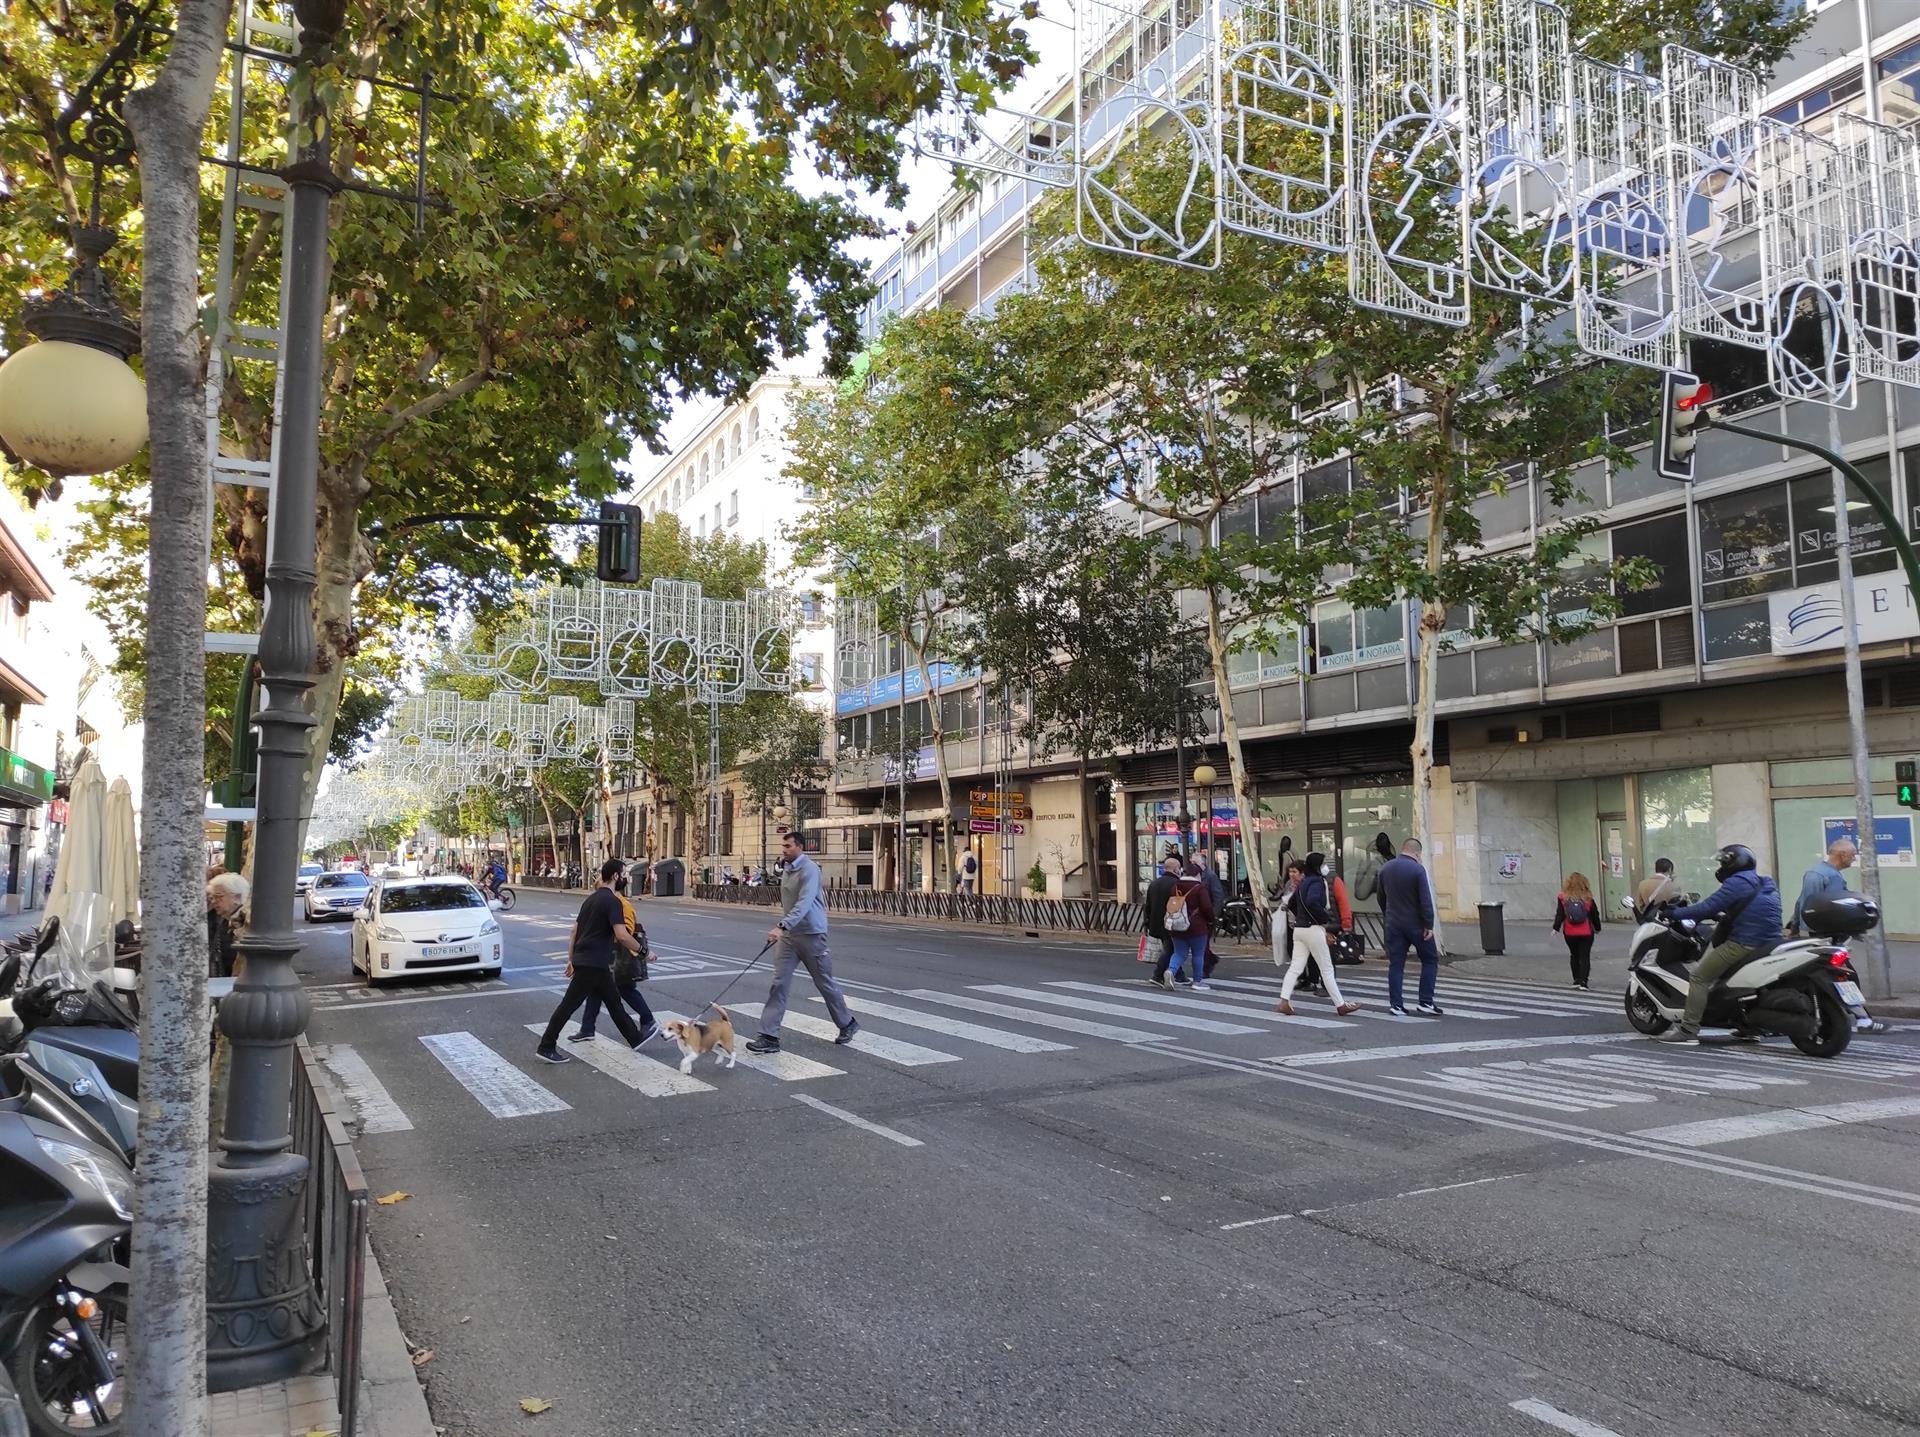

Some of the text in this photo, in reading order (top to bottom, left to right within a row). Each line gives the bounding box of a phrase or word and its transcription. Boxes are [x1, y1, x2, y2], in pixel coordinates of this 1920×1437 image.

[1366, 644, 1401, 659] NOTARIA
[1329, 653, 1354, 666] NOTAR
[1070, 834, 1080, 847] 27
